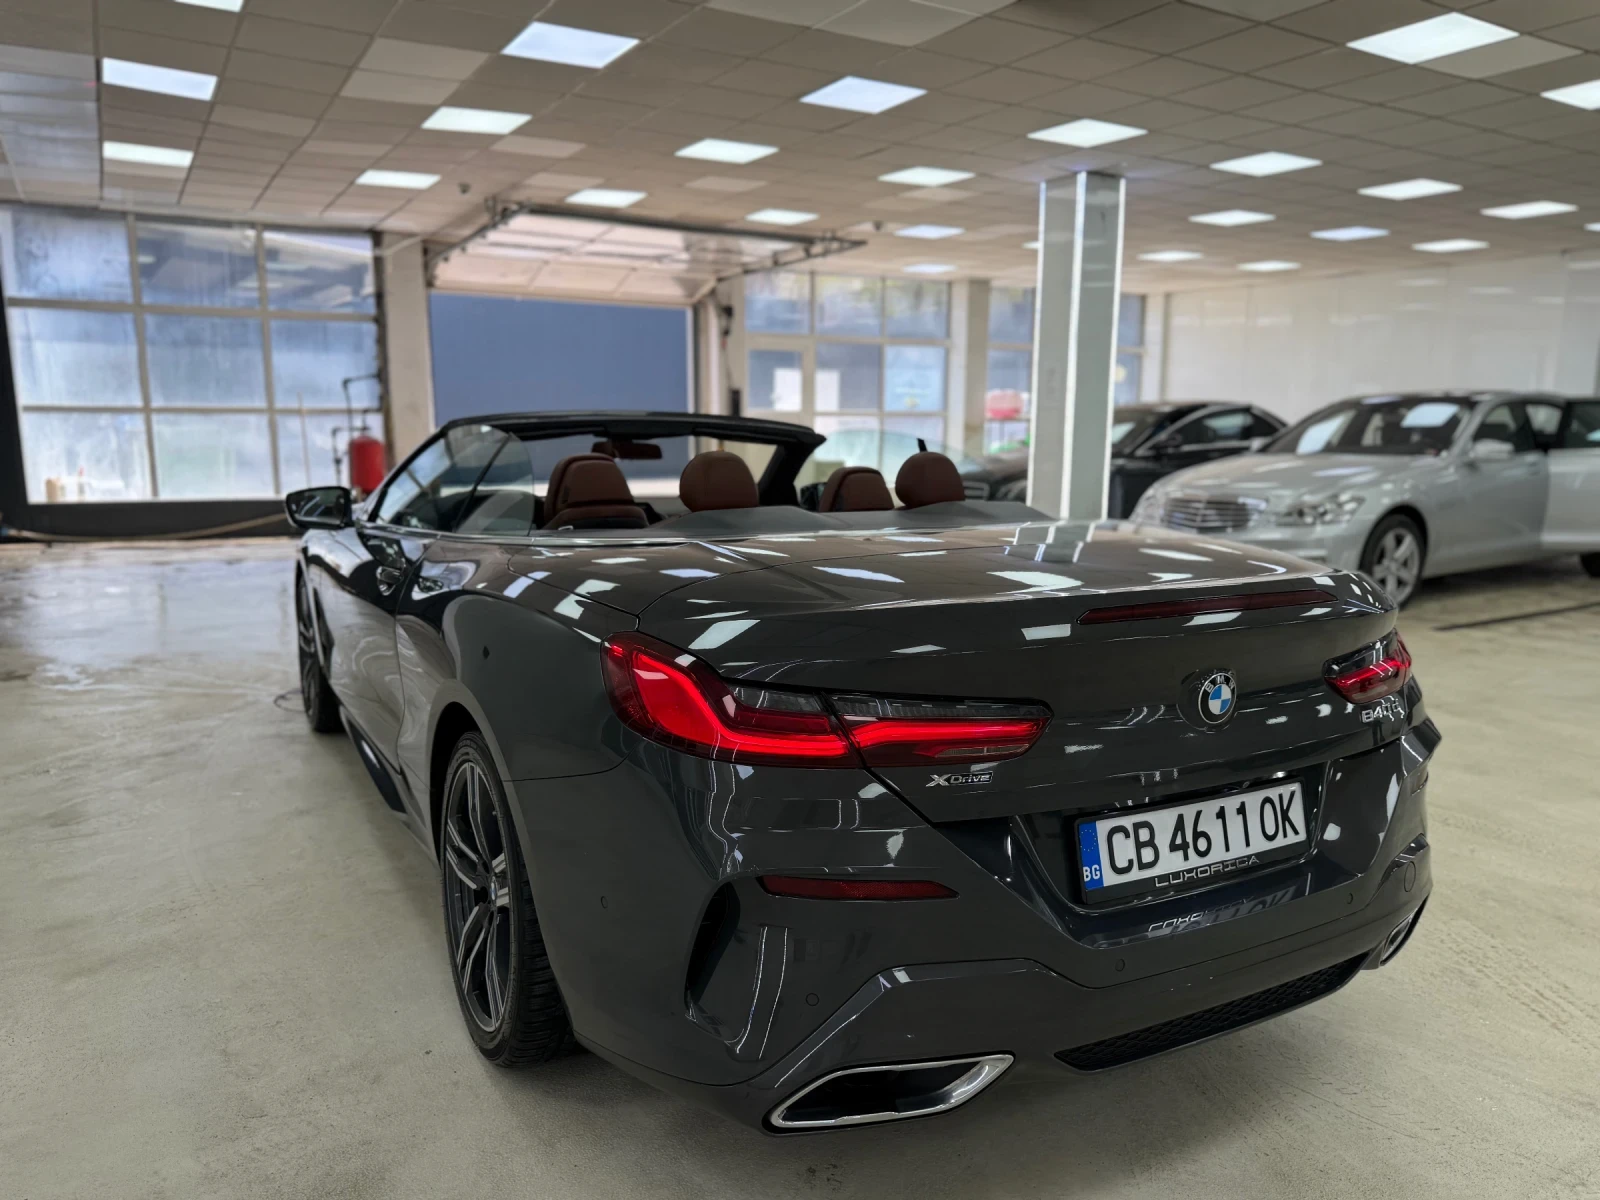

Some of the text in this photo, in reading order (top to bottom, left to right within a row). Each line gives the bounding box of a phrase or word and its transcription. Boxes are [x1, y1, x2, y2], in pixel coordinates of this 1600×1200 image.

[1204, 675, 1236, 693] BMW
[1106, 820, 1160, 876] CB
[1169, 801, 1251, 862] 4611
[1083, 864, 1101, 882] BG
